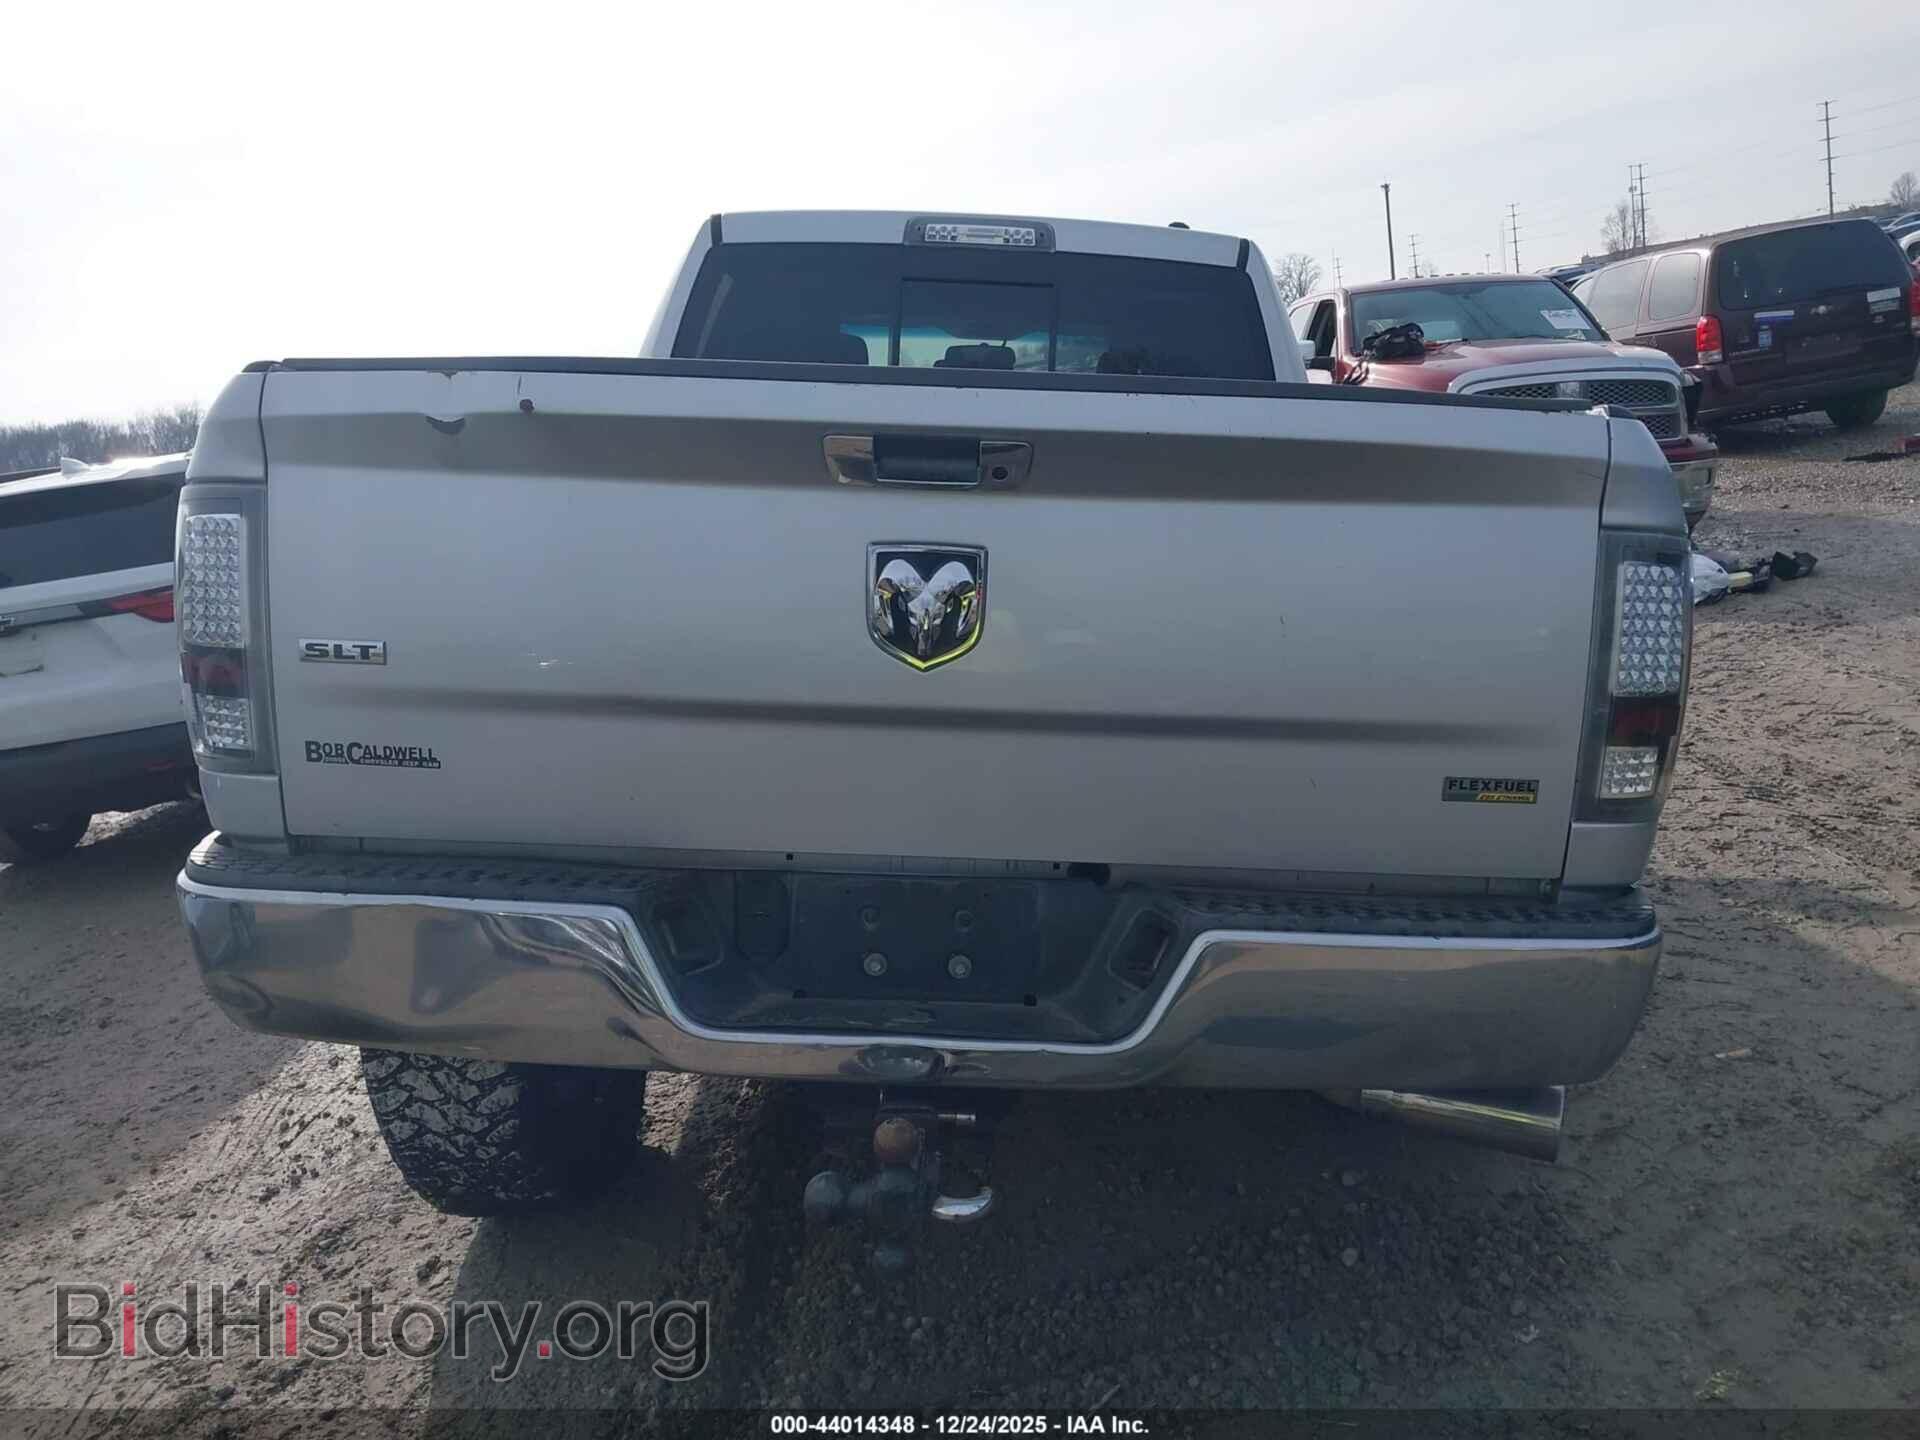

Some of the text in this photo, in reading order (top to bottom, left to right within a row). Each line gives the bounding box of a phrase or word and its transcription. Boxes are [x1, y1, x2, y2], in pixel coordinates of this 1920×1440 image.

[304, 642, 378, 660] SLT
[305, 740, 438, 762] BOB CALDWELL
